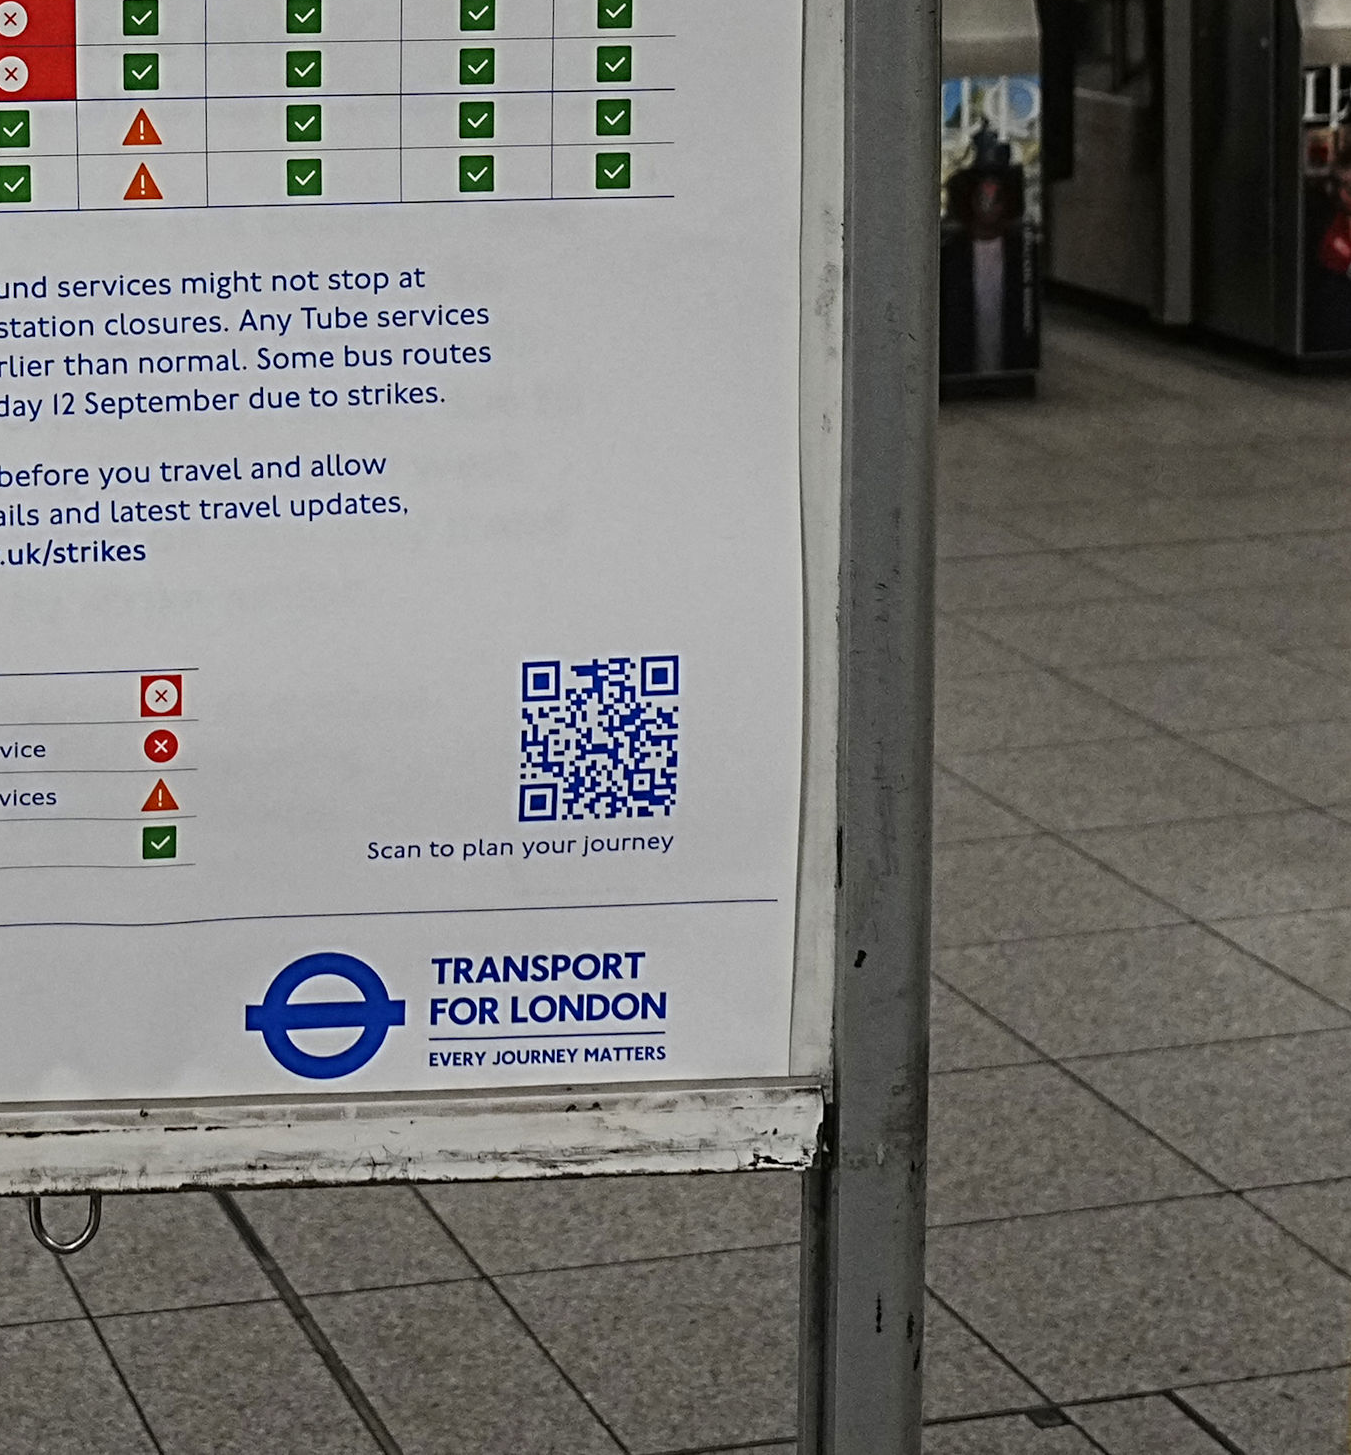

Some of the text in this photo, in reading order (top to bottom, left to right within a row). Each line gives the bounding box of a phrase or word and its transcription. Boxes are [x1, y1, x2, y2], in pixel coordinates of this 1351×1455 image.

[57, 274, 172, 299] services
[181, 270, 263, 300] might
[271, 270, 320, 292] not
[327, 269, 390, 296] stop
[398, 267, 426, 289] at
[53, 391, 76, 416] 12
[84, 388, 240, 420] September
[248, 386, 301, 410] due
[308, 386, 339, 408] to
[347, 381, 446, 407] strikes.
[97, 465, 150, 491] you
[159, 456, 243, 483] travel
[250, 454, 301, 480] and
[310, 453, 387, 478] allow
[367, 835, 675, 862] Scan to plan your journey
[430, 951, 647, 985] TRANSPORT
[429, 991, 667, 1026] FOR LONDON
[428, 1045, 667, 1068] EVERY JOURNEY MATTERS
